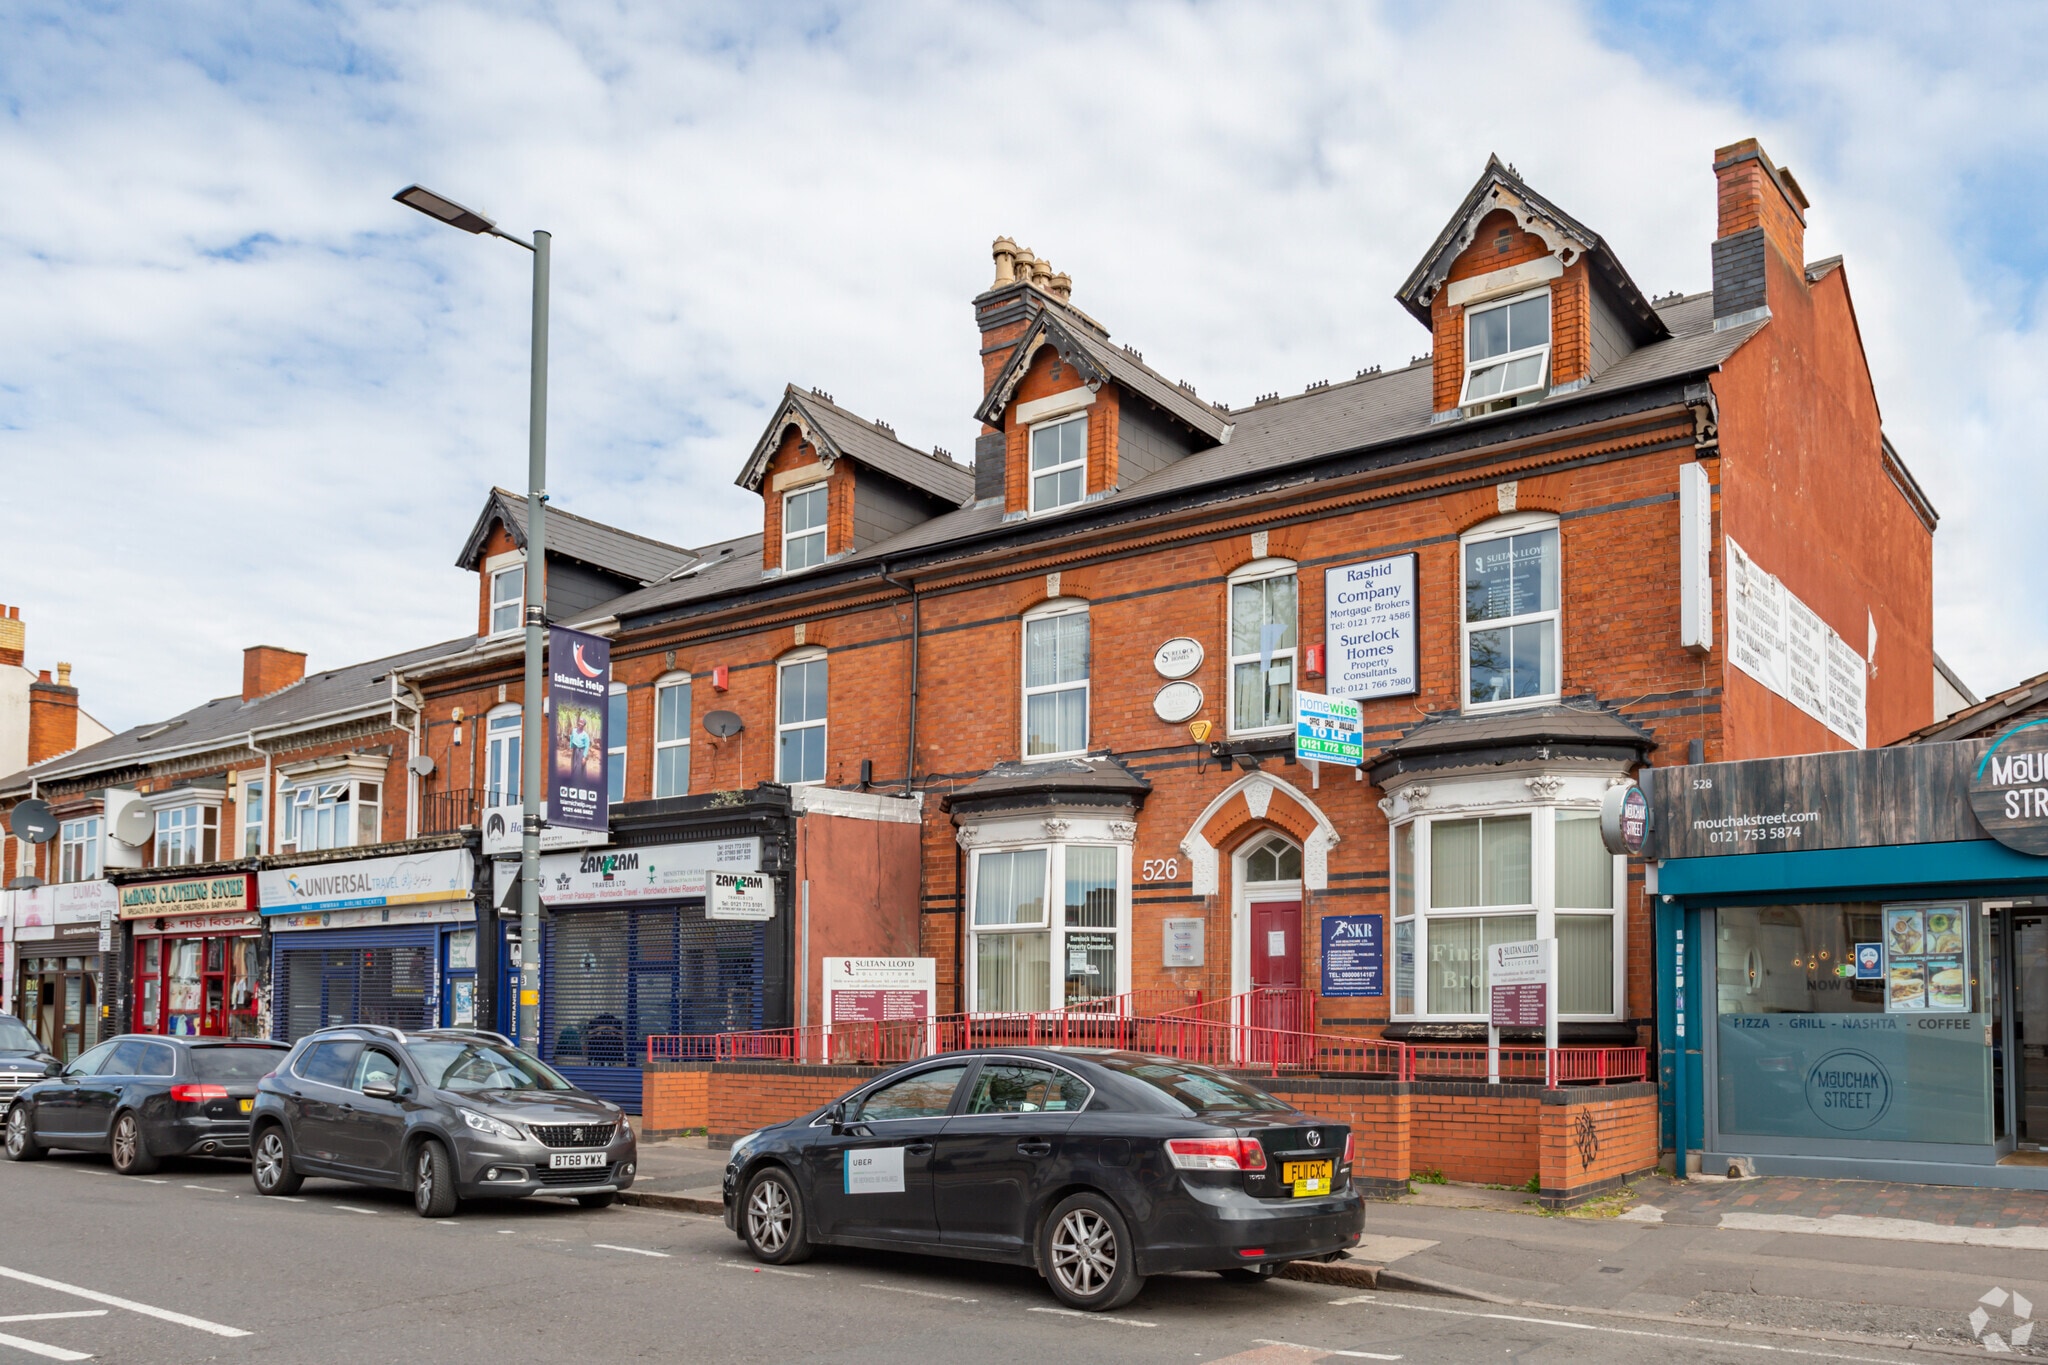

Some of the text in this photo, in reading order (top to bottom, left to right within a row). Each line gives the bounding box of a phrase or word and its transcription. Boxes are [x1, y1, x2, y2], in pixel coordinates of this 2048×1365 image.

[1347, 563, 1392, 582] Rashid
[1364, 580, 1374, 589] &
[1338, 585, 1402, 604] Company
[1330, 599, 1410, 619] Mortgage Brokers
[1330, 610, 1410, 631] Tel: 0121 772 4586
[1340, 628, 1400, 646] Surelock
[1347, 644, 1394, 660] Homes
[1351, 658, 1389, 670] Property
[1344, 666, 1398, 681] Consultants
[554, 672, 604, 694] Islamic Help
[1331, 676, 1412, 694] Tel: 0121 766 7980
[1300, 694, 1358, 718] homewise
[1311, 726, 1352, 742] TO LET
[1301, 740, 1360, 756] 0121 772 1924
[1992, 753, 2048, 786] MOU
[1692, 779, 1712, 790] 528
[1627, 820, 1643, 836] STREET
[1694, 811, 1818, 830] mouchakstreet.com
[1710, 826, 1801, 843] 0121 753 5874
[580, 852, 638, 874] ZAM ZAM
[1142, 858, 1178, 881] 526
[306, 872, 372, 896] UNIVERSAL
[372, 876, 399, 889] TRAVEL
[592, 880, 615, 888] TRAVELS
[716, 874, 762, 888] ZAM ZAM
[73, 884, 102, 900] DUMAS
[160, 882, 208, 904] CLOTHING
[212, 878, 244, 899] STORE
[288, 918, 304, 927] FedEx
[1348, 923, 1373, 938] SKR
[1504, 945, 1522, 956] SULTAN
[856, 960, 915, 968] SULTAN LLOYD
[1807, 980, 1886, 991] NOW OPEN
[1734, 1018, 1971, 1030] PIZZA GRILL NASHTA COFFEE
[1818, 1070, 1879, 1089] MOUCHAK
[1824, 1092, 1872, 1109] STREET
[554, 1153, 603, 1166] BT68 YWX
[852, 1158, 872, 1166] UBER
[1310, 1164, 1326, 1178] CXC
